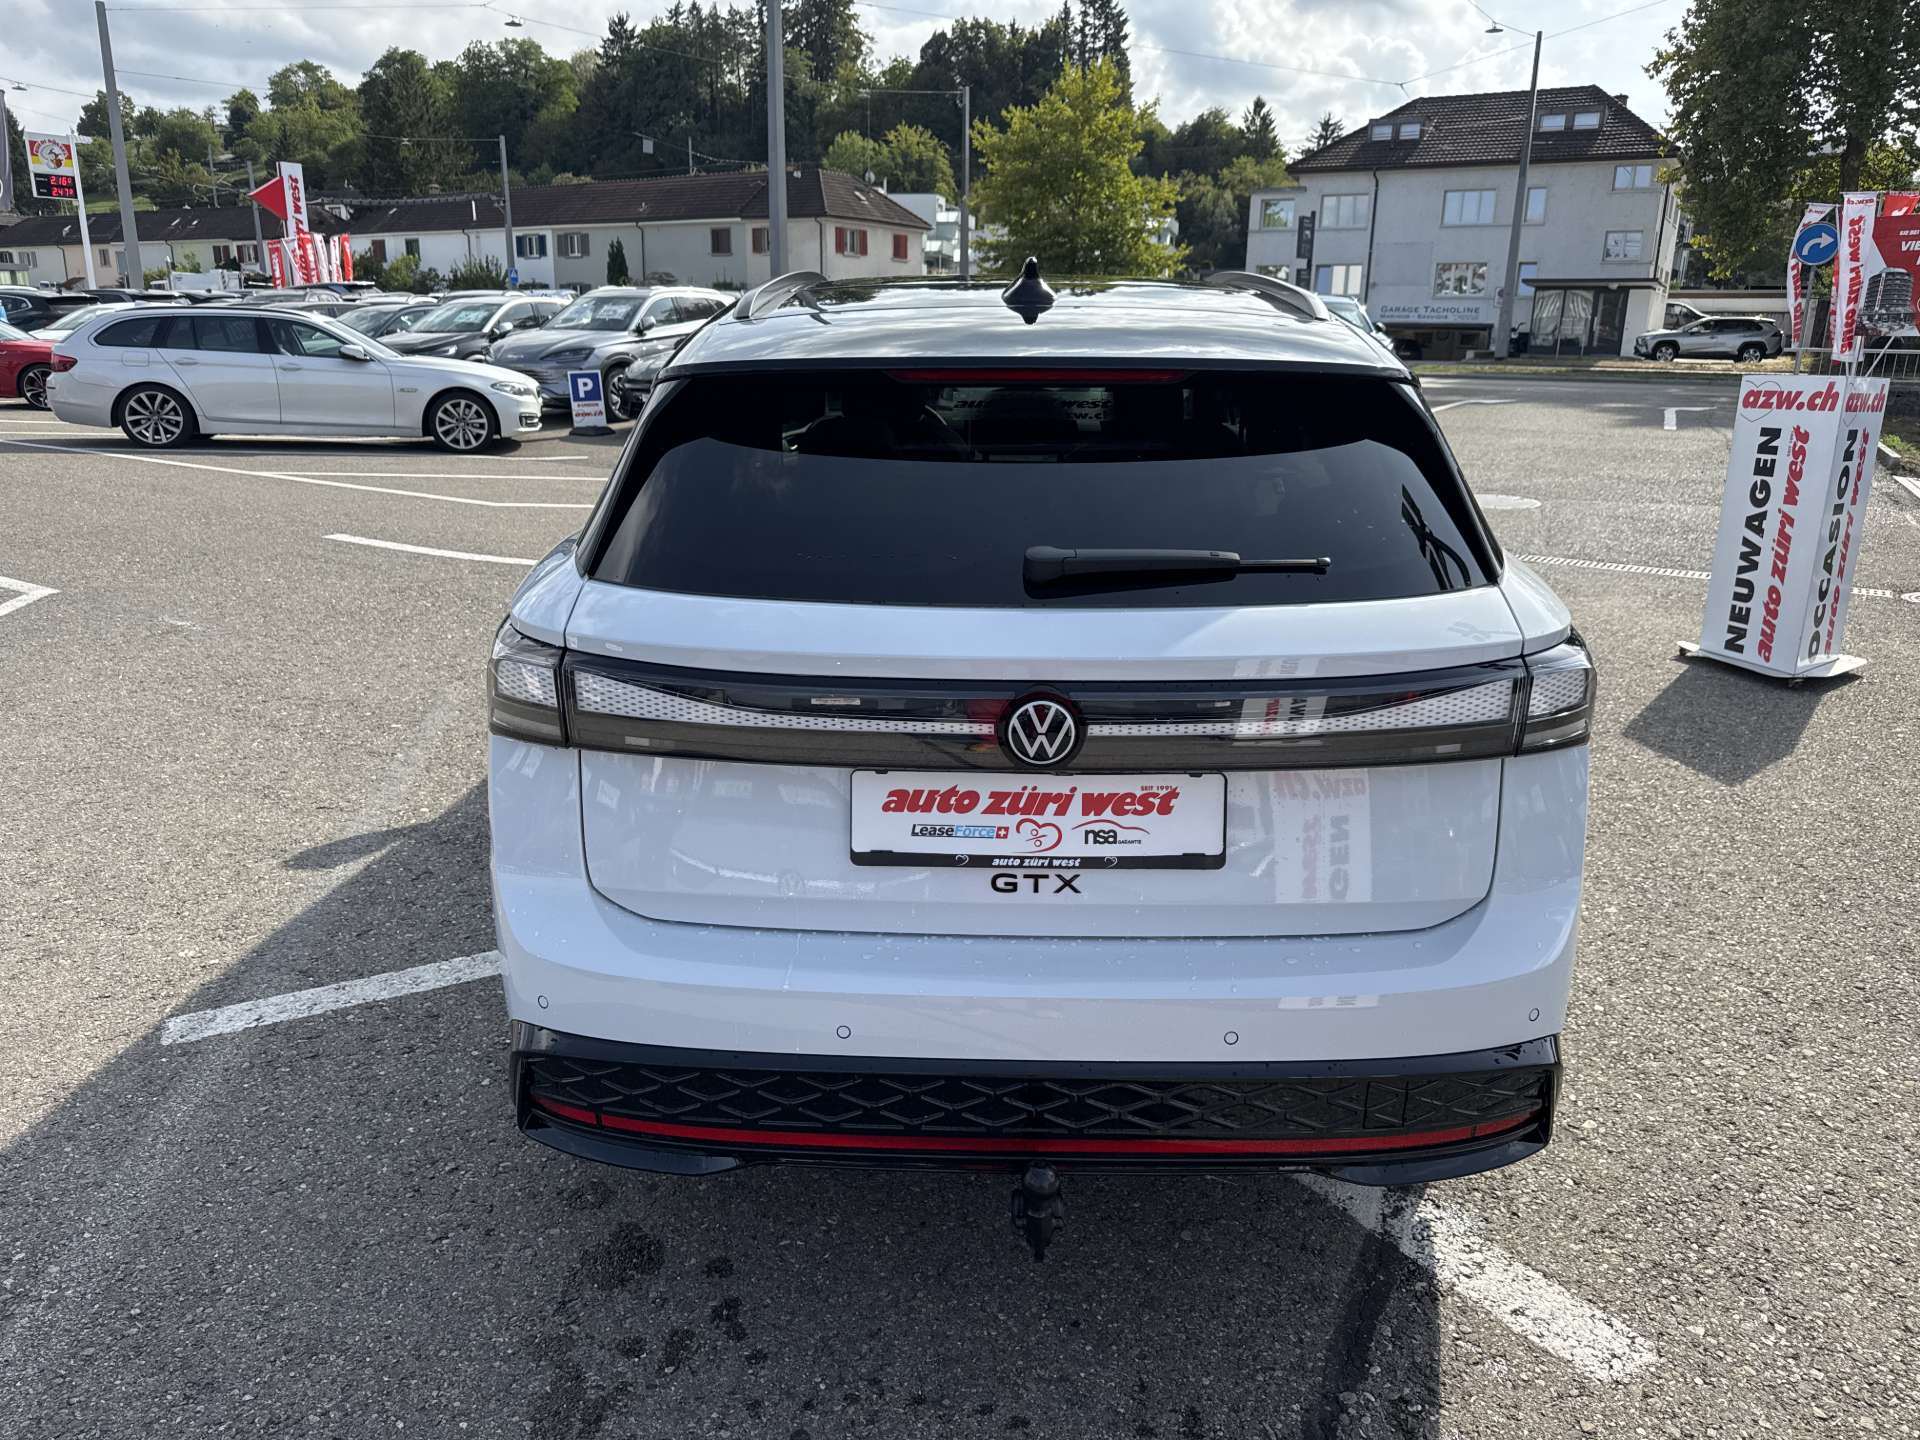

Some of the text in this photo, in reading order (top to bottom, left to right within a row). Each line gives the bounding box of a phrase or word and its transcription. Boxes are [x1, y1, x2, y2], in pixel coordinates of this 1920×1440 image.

[288, 174, 302, 215] west
[1380, 305, 1480, 314] GARAGE TACHOLINE
[577, 378, 593, 398] P
[1742, 381, 1840, 412] azw.ch
[1845, 384, 1886, 413] azw.ch
[1724, 426, 1782, 655] NEUWAGEN
[1757, 424, 1810, 664] auto züri west
[1824, 426, 1870, 656] auto züri west
[882, 784, 1180, 818] auto züri west
[911, 824, 996, 838] LeaseForce
[1084, 829, 1118, 845] nsa
[992, 856, 1081, 868] auto züri west
[990, 873, 1082, 894] GTX
